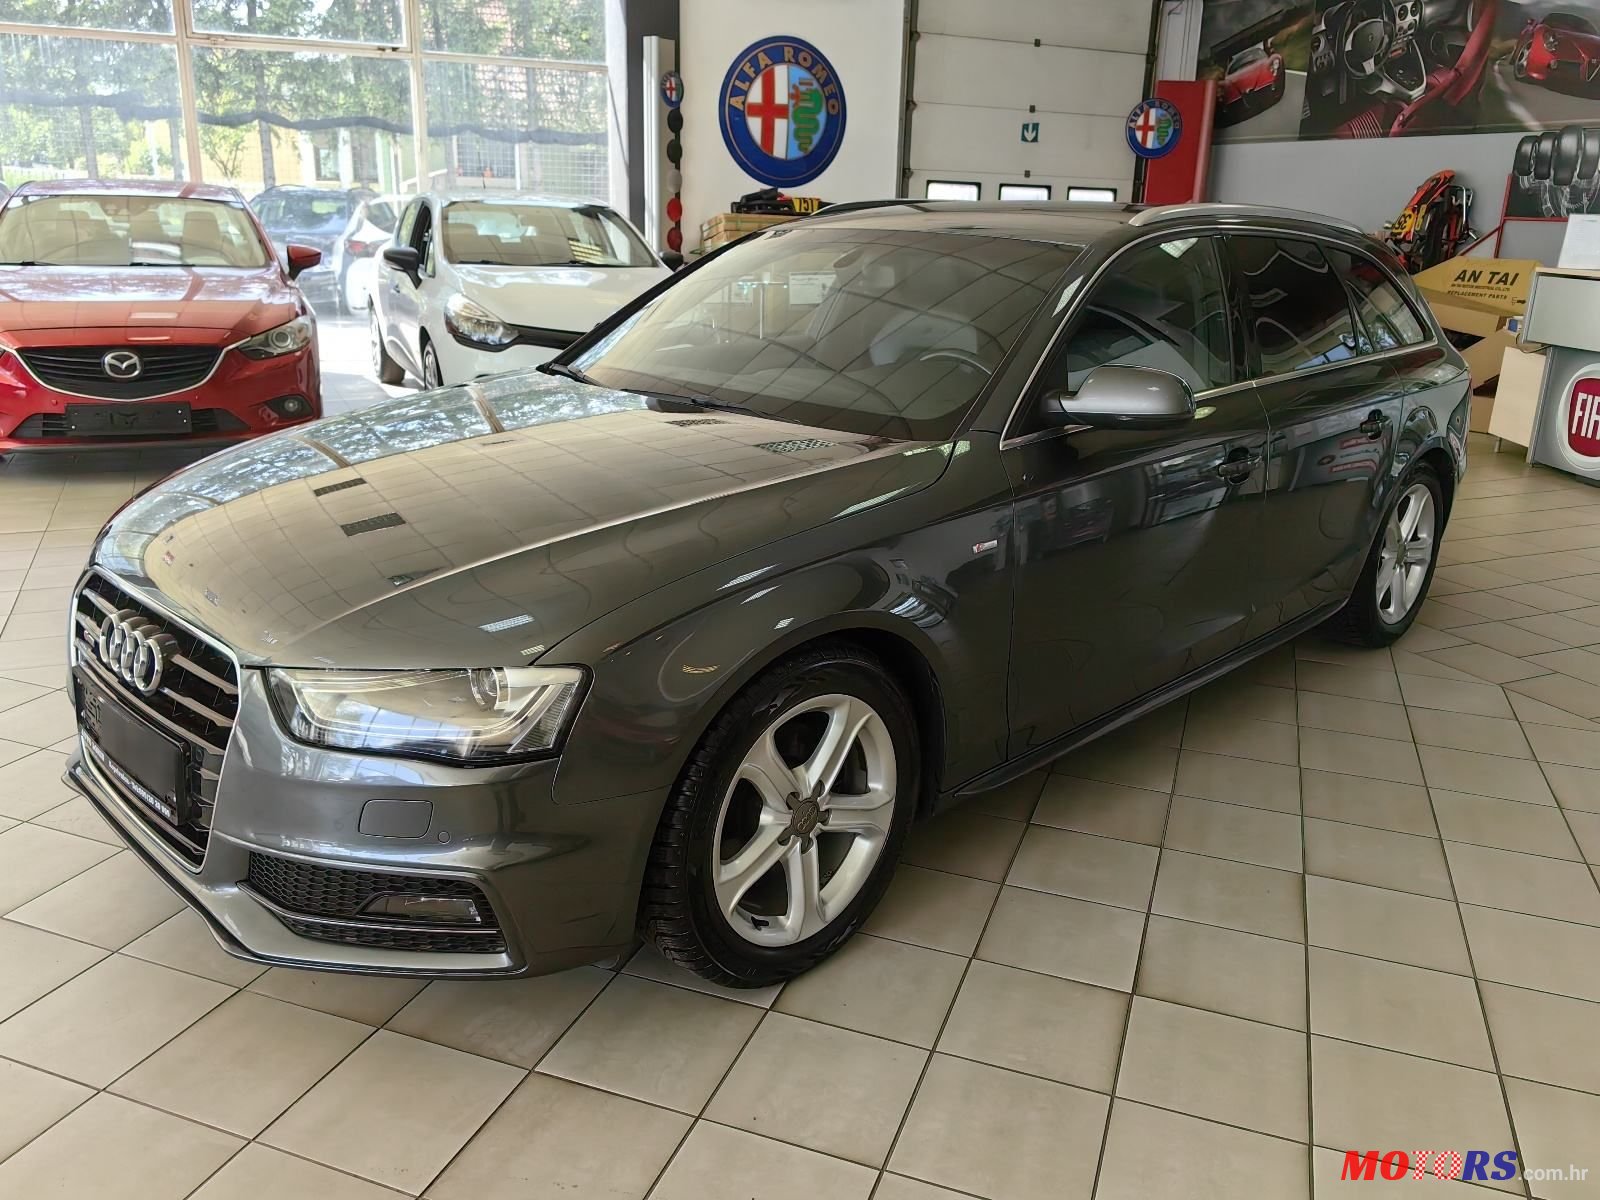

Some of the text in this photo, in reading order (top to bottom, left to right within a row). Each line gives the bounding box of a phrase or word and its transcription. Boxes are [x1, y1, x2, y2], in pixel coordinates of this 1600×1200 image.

[730, 46, 839, 115] ALFA ROMEO
[1454, 269, 1519, 286] AN TAI
[1447, 290, 1487, 298] REPLACEMENT
